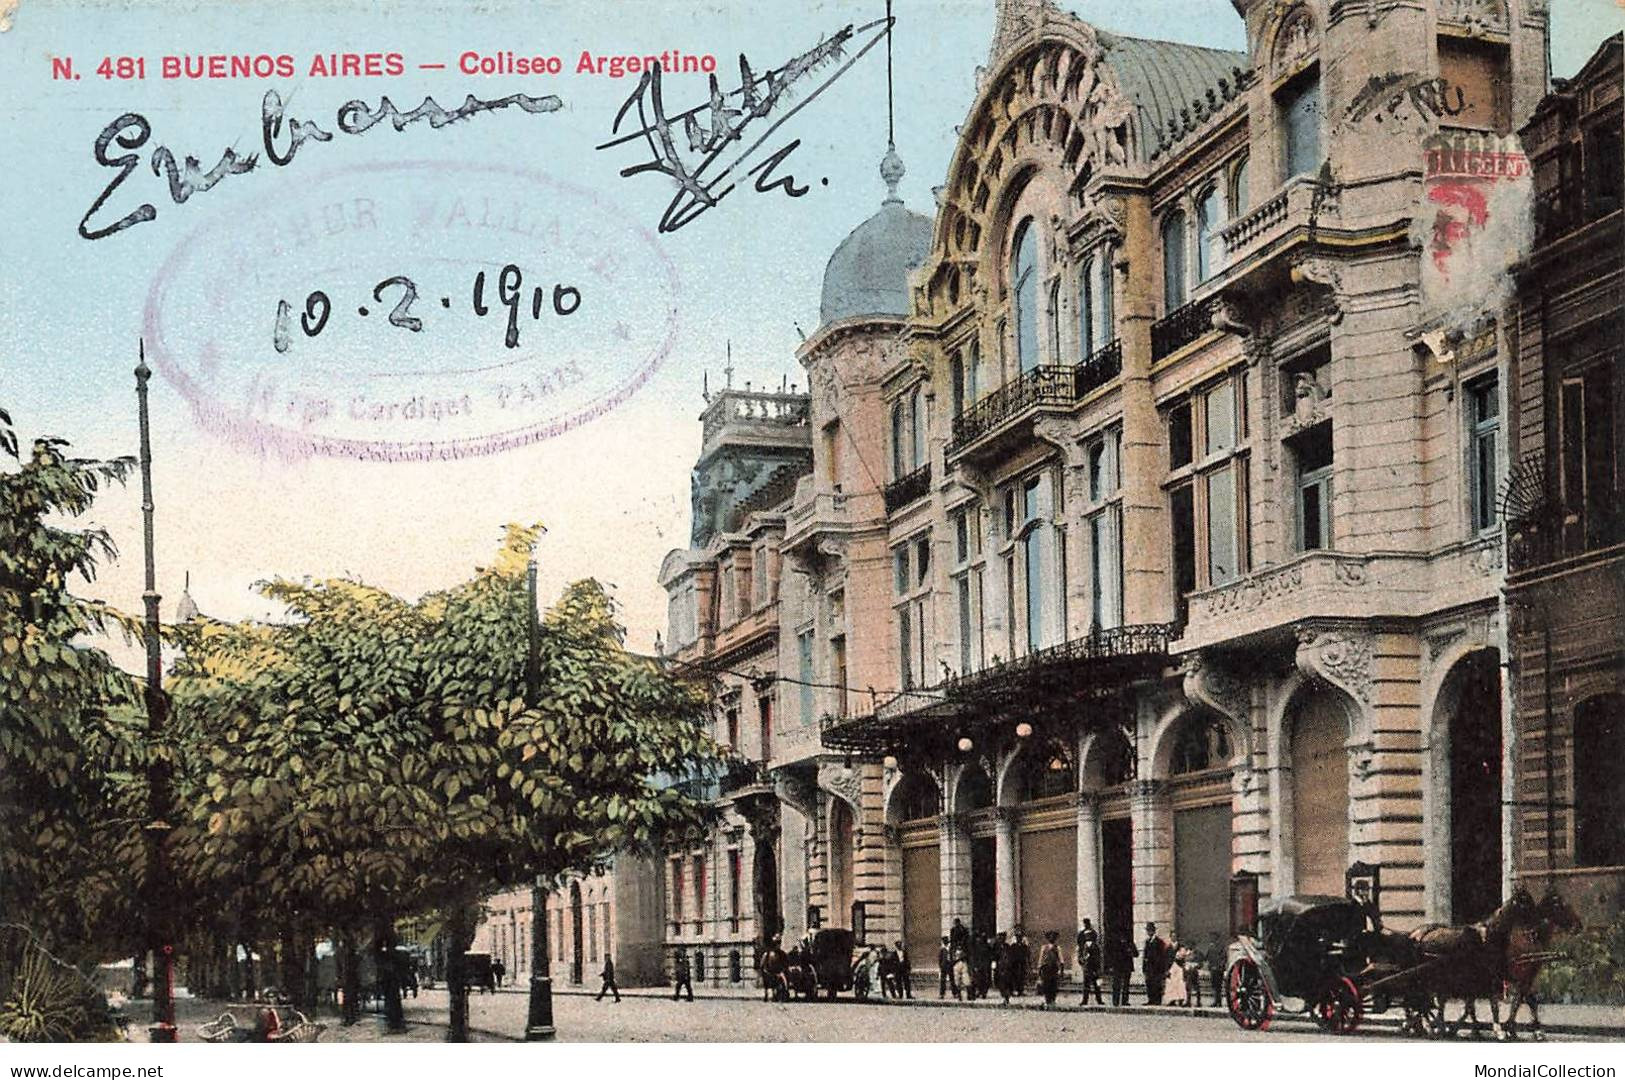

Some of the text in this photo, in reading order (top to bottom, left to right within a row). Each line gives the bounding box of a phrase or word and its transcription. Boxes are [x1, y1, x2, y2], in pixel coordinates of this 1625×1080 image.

[52, 58, 81, 80] N.
[96, 57, 146, 80] 481
[162, 55, 296, 79] BUENOS
[309, 52, 404, 77] AIRES
[458, 49, 562, 76] Coliseo
[575, 49, 718, 78] Argentino
